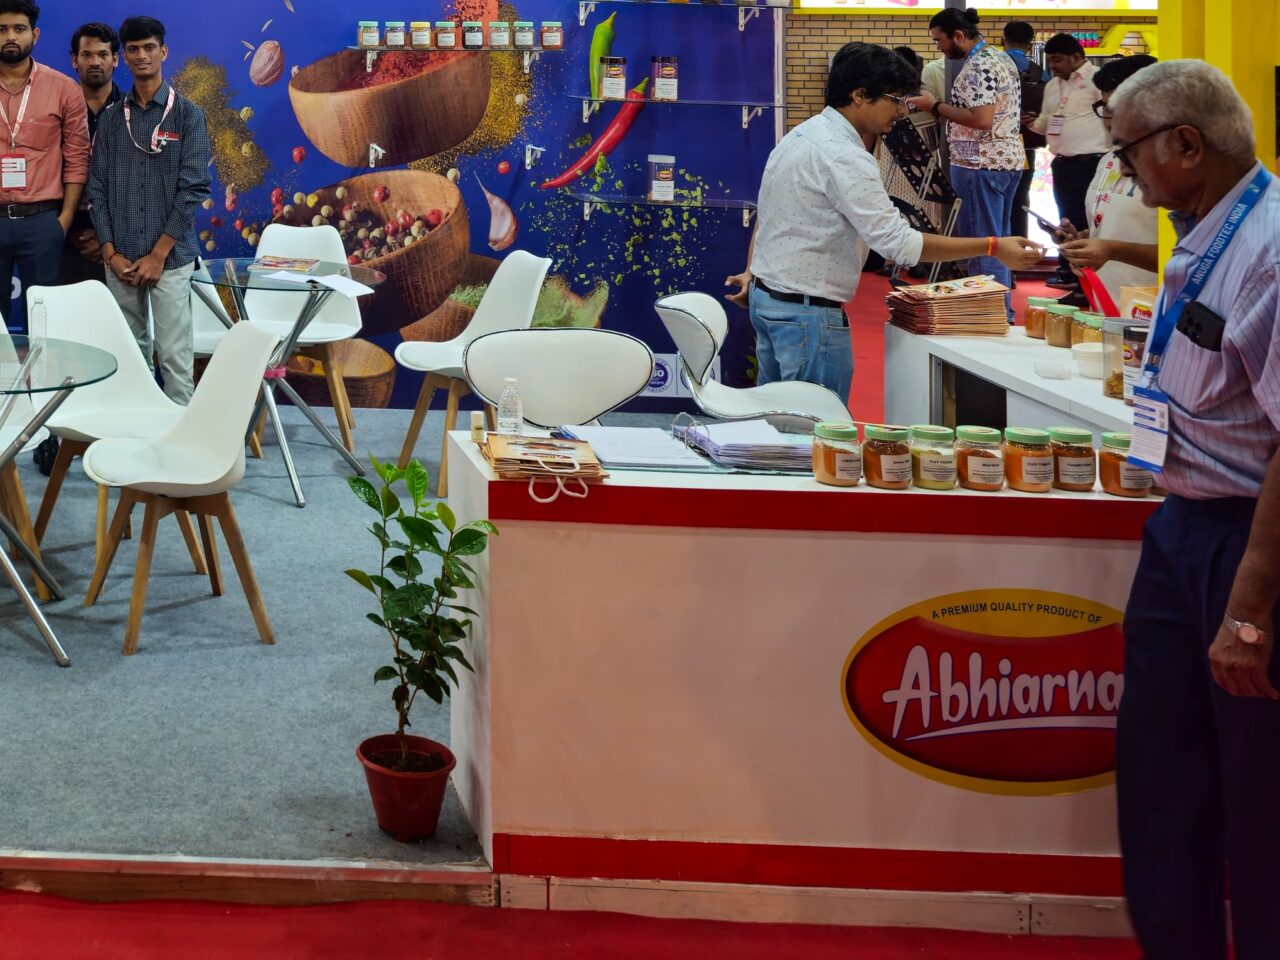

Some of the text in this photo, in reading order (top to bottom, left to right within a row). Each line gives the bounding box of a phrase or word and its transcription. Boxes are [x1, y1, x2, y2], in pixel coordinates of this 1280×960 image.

[1192, 203, 1248, 285] ANUGA FOODTEC INDIA
[932, 602, 1102, 624] A PREMIUM QUALITY PRODUCT OF
[882, 645, 1124, 739] Abhiarna
